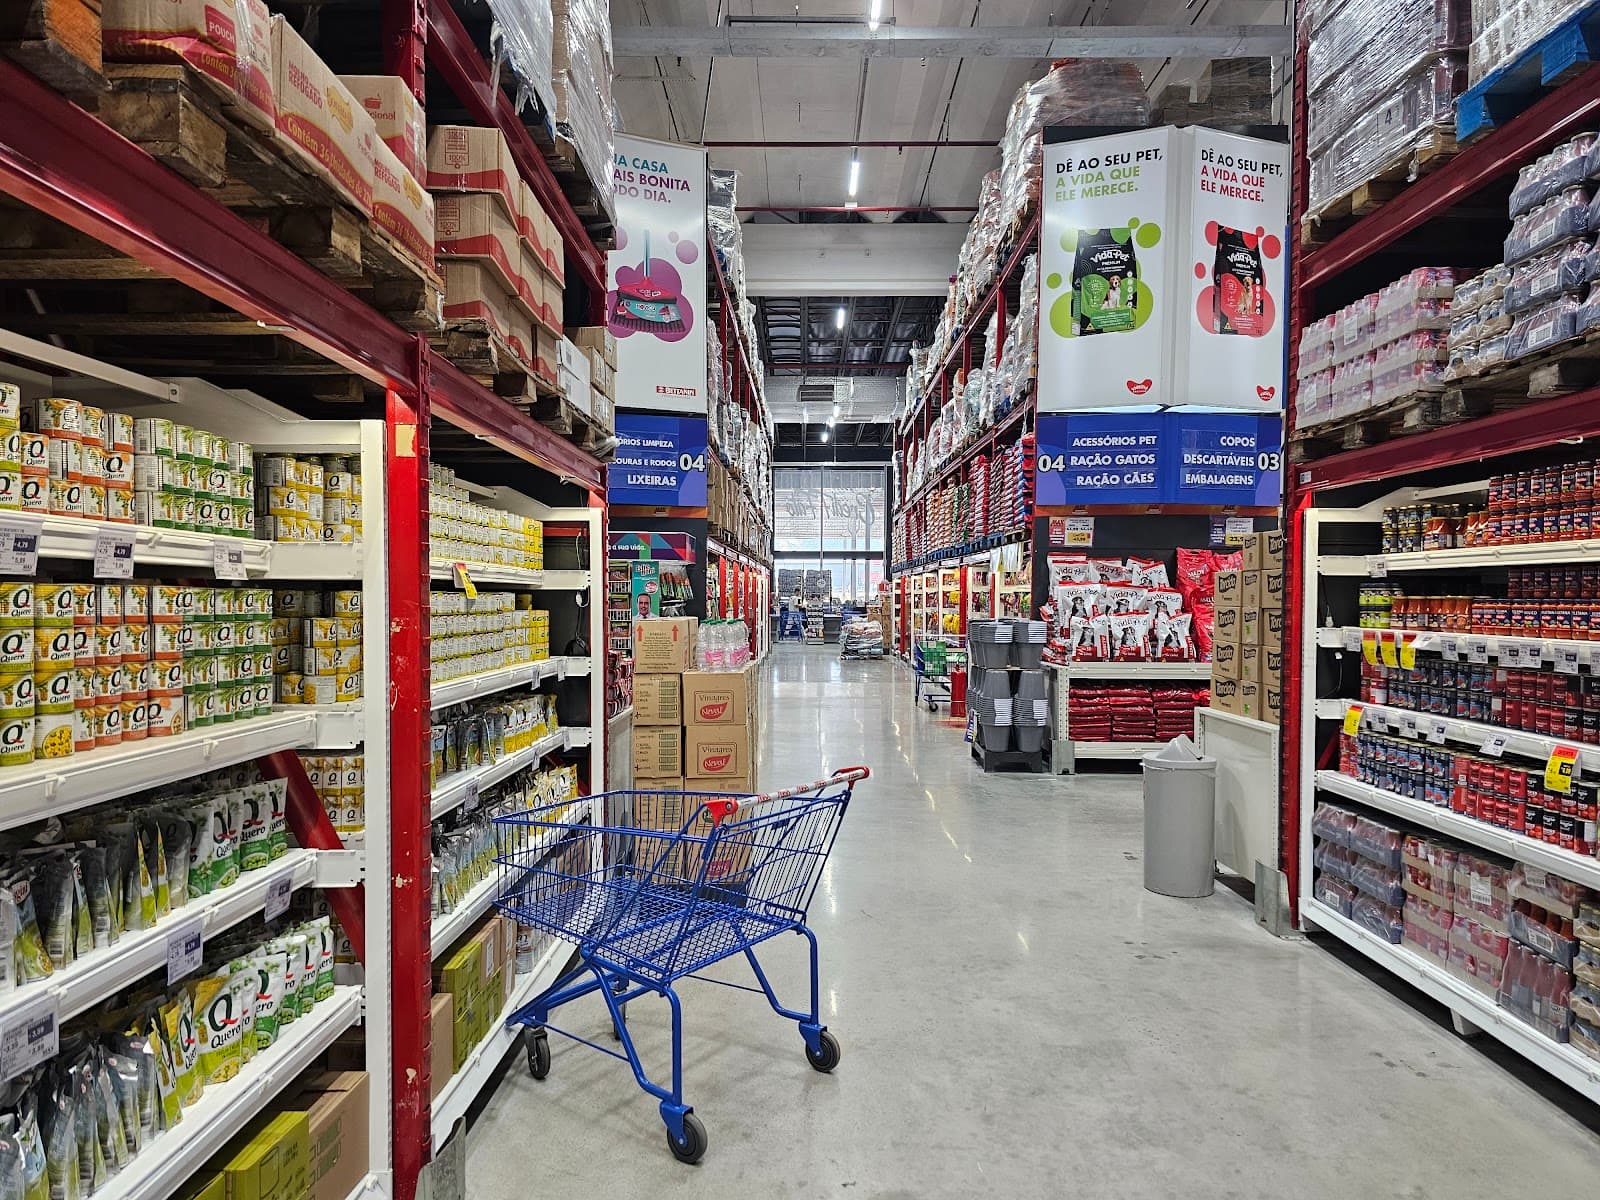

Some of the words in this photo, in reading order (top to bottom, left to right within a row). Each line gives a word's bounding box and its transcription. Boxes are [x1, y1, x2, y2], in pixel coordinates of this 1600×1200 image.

[209, 22, 234, 42] POUCH
[289, 70, 322, 109] REFOGADO
[368, 111, 395, 120] cional
[287, 118, 319, 154] Contém
[320, 142, 330, 163] 36
[632, 158, 668, 174] CASA
[1056, 158, 1072, 173] DÊ
[1078, 157, 1099, 170] AO
[1105, 153, 1130, 167] SEU
[1136, 148, 1163, 162] PET,
[1201, 149, 1213, 161] DÊ
[1218, 155, 1234, 167] AO
[1238, 158, 1258, 171] SEU
[1262, 162, 1283, 178] PET,
[374, 166, 400, 194] REFOGADO
[639, 173, 690, 192] BONITA
[1056, 177, 1065, 188] A
[1070, 172, 1105, 186] VIDA
[1110, 166, 1140, 180] QUE
[1201, 165, 1209, 176] A
[1212, 167, 1237, 181] VIDA
[1242, 174, 1264, 187] QUE
[644, 189, 671, 203] DIA.
[1056, 189, 1076, 201] ELE
[1081, 181, 1138, 198] MERECE.
[1201, 180, 1216, 193] ELE
[1220, 184, 1264, 202] MERECE.
[643, 440, 673, 448] LIMPEZA
[1073, 435, 1136, 447] ACESSÓRIOS
[1139, 436, 1157, 445] PET
[1220, 436, 1255, 447] COPOS
[680, 454, 705, 472] 04
[1038, 455, 1065, 472] 04
[1070, 454, 1111, 467] RAÇÃO
[1115, 454, 1155, 465] GATOS
[1184, 453, 1254, 466] DESCARTÁVEIS
[1258, 453, 1280, 470] 03
[628, 475, 676, 486] LIXEIRAS
[1077, 472, 1120, 487] RAÇÃO
[1124, 472, 1154, 484] CÃES
[1186, 474, 1253, 485] EMBALAGENS
[208, 994, 239, 1029] Q
[210, 1022, 241, 1049] Quero
